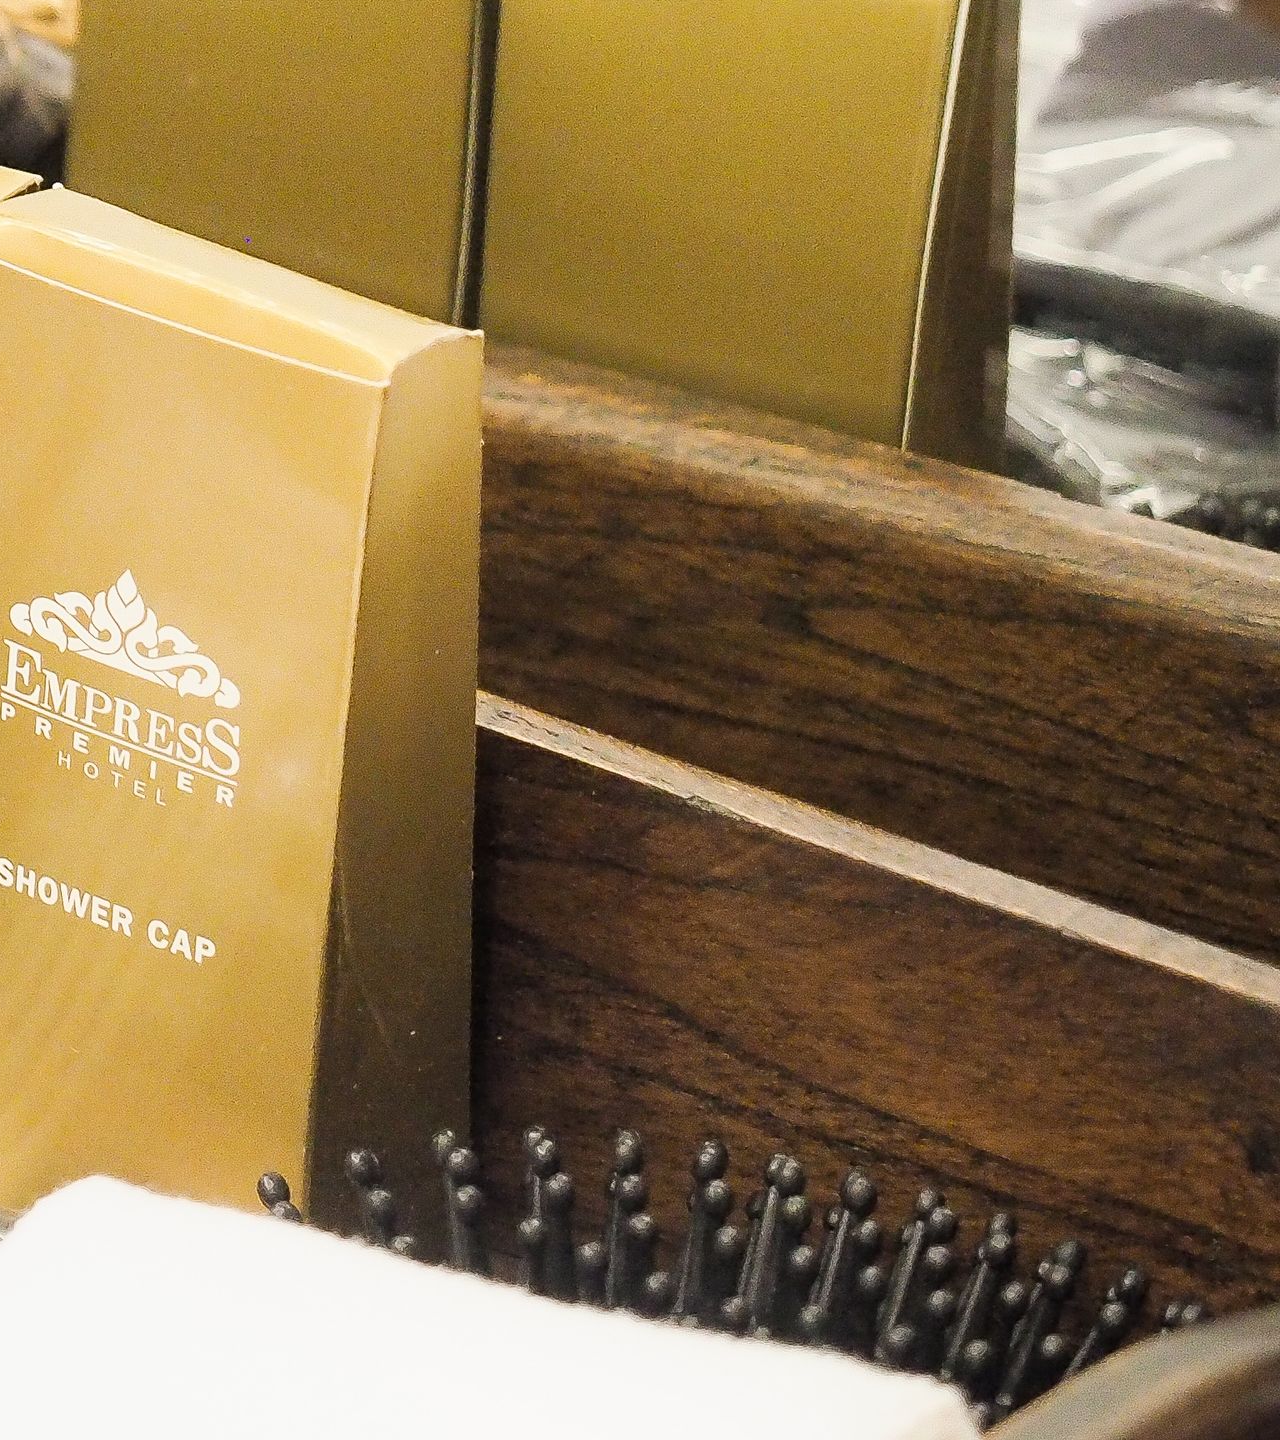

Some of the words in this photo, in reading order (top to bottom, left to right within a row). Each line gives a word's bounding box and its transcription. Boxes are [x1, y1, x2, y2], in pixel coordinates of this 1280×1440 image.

[0, 638, 240, 777] EMPRESS
[1, 701, 235, 808] PREMIER
[58, 750, 167, 806] HOTEL
[146, 919, 217, 967] CAP
